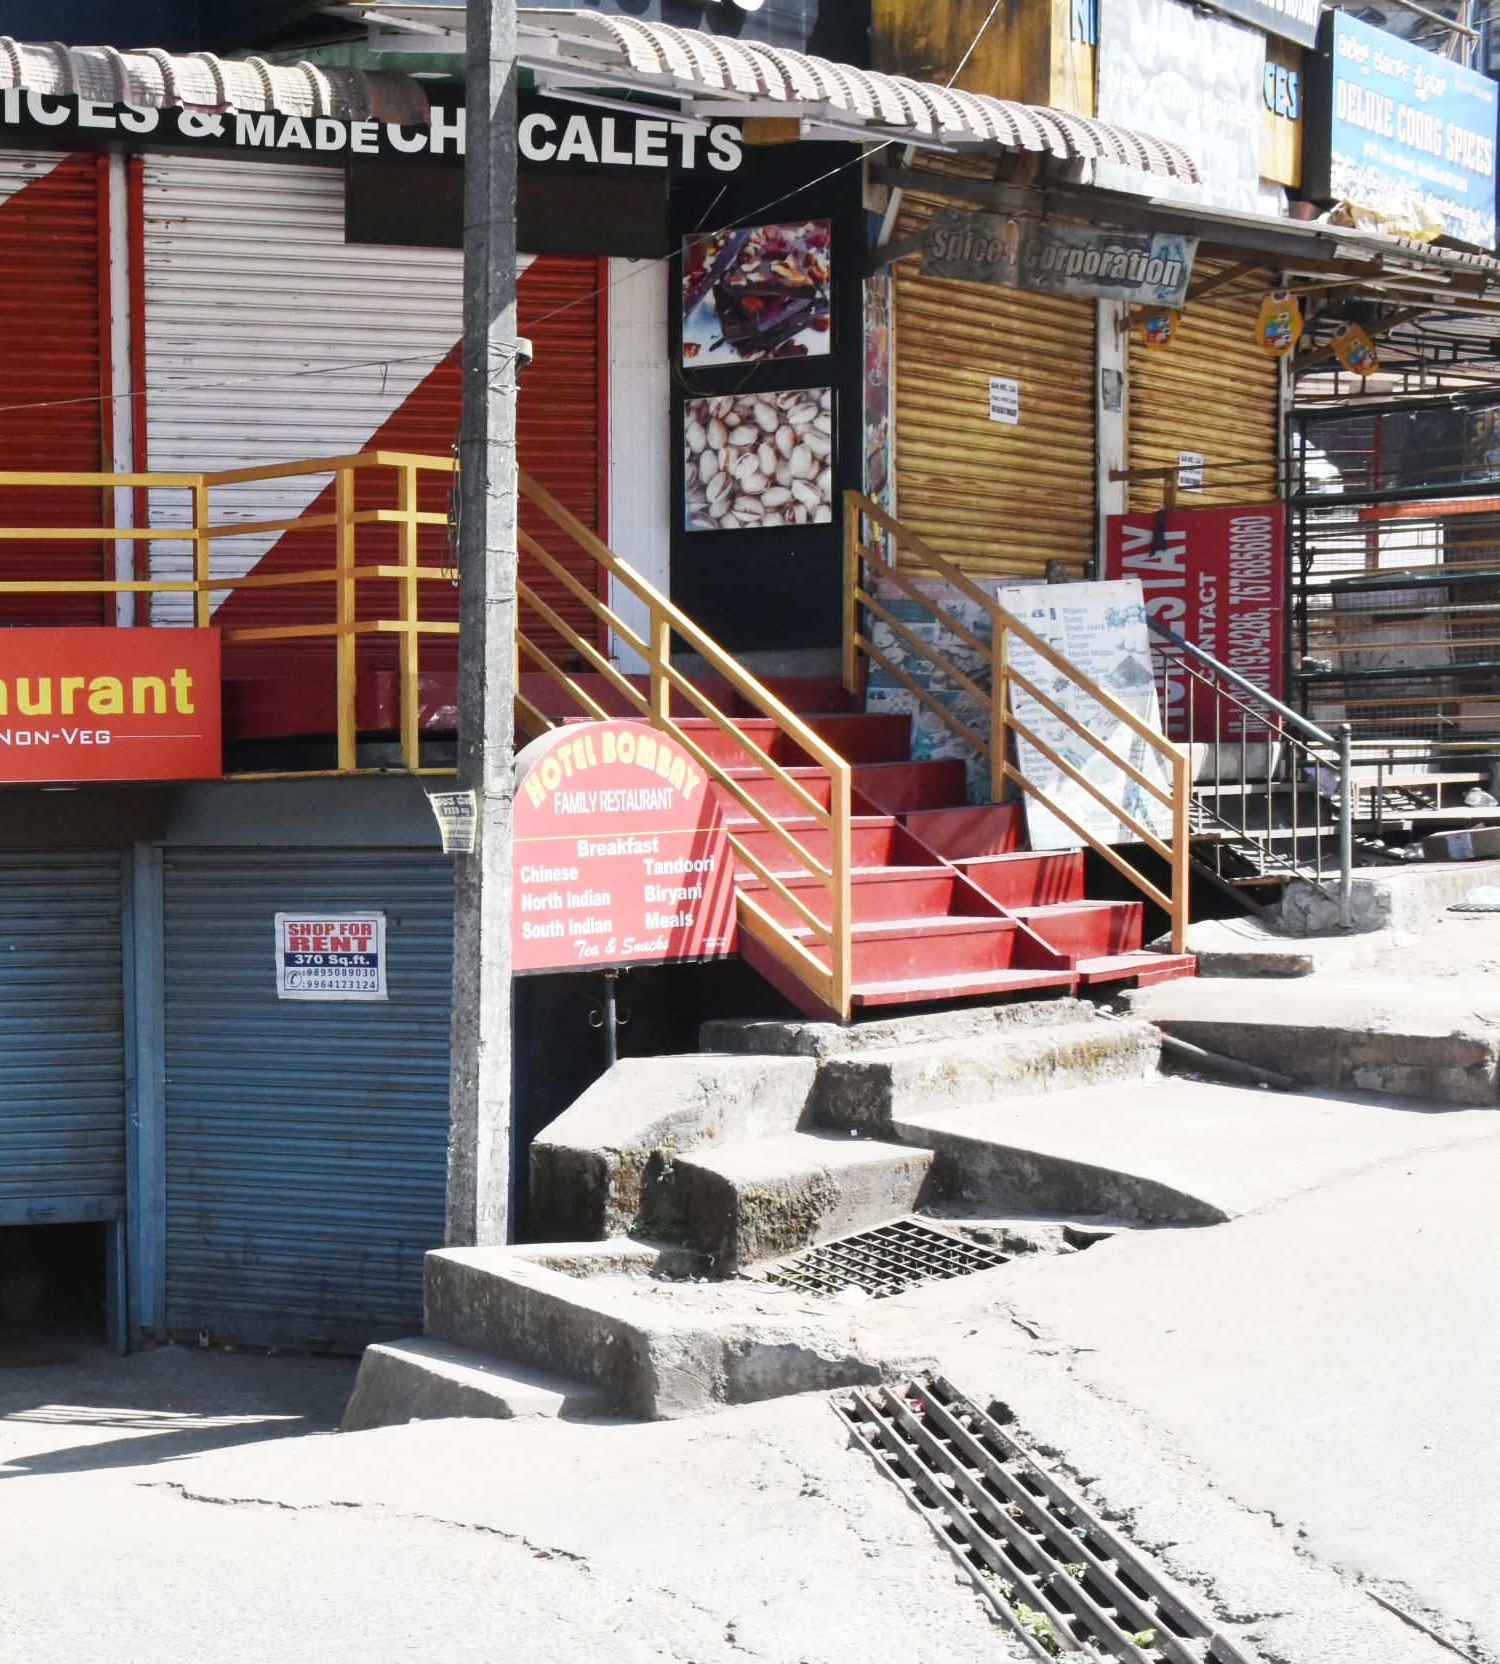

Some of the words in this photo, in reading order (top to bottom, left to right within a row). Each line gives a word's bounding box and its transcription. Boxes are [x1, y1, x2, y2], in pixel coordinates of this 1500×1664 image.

[1108, 63, 1145, 98] New
[1150, 75, 1198, 121] Coorg
[1203, 89, 1256, 129] Spices
[177, 102, 227, 138] &
[236, 113, 380, 155] MADE
[386, 105, 743, 172] CHCALETS
[1336, 76, 1394, 138] DELUXE
[1397, 101, 1443, 156] COORG
[1445, 122, 1493, 177] SPICES
[932, 228, 1014, 266] Spice
[1024, 238, 1183, 288] Corporation
[523, 734, 598, 810] HOTEL
[601, 731, 702, 801] BOMBAY
[553, 790, 597, 816] FAMILY
[599, 787, 675, 813] RESTAURANT
[576, 836, 660, 858] Breakfast
[520, 864, 579, 885] Chinese
[642, 855, 716, 876] Tandoori
[521, 893, 563, 912] North
[566, 890, 611, 910] Indian
[643, 881, 703, 904] Biryani
[288, 923, 336, 936] SHOP
[339, 923, 373, 936] FOR
[522, 920, 565, 940] South
[567, 917, 613, 937] Indian
[644, 911, 694, 930] Meals
[289, 936, 373, 952] RENT
[572, 939, 601, 959] Tea
[605, 940, 618, 955] &
[620, 934, 671, 954] Snacks
[294, 954, 324, 965] 370
[328, 954, 371, 967] Sq.ft.
